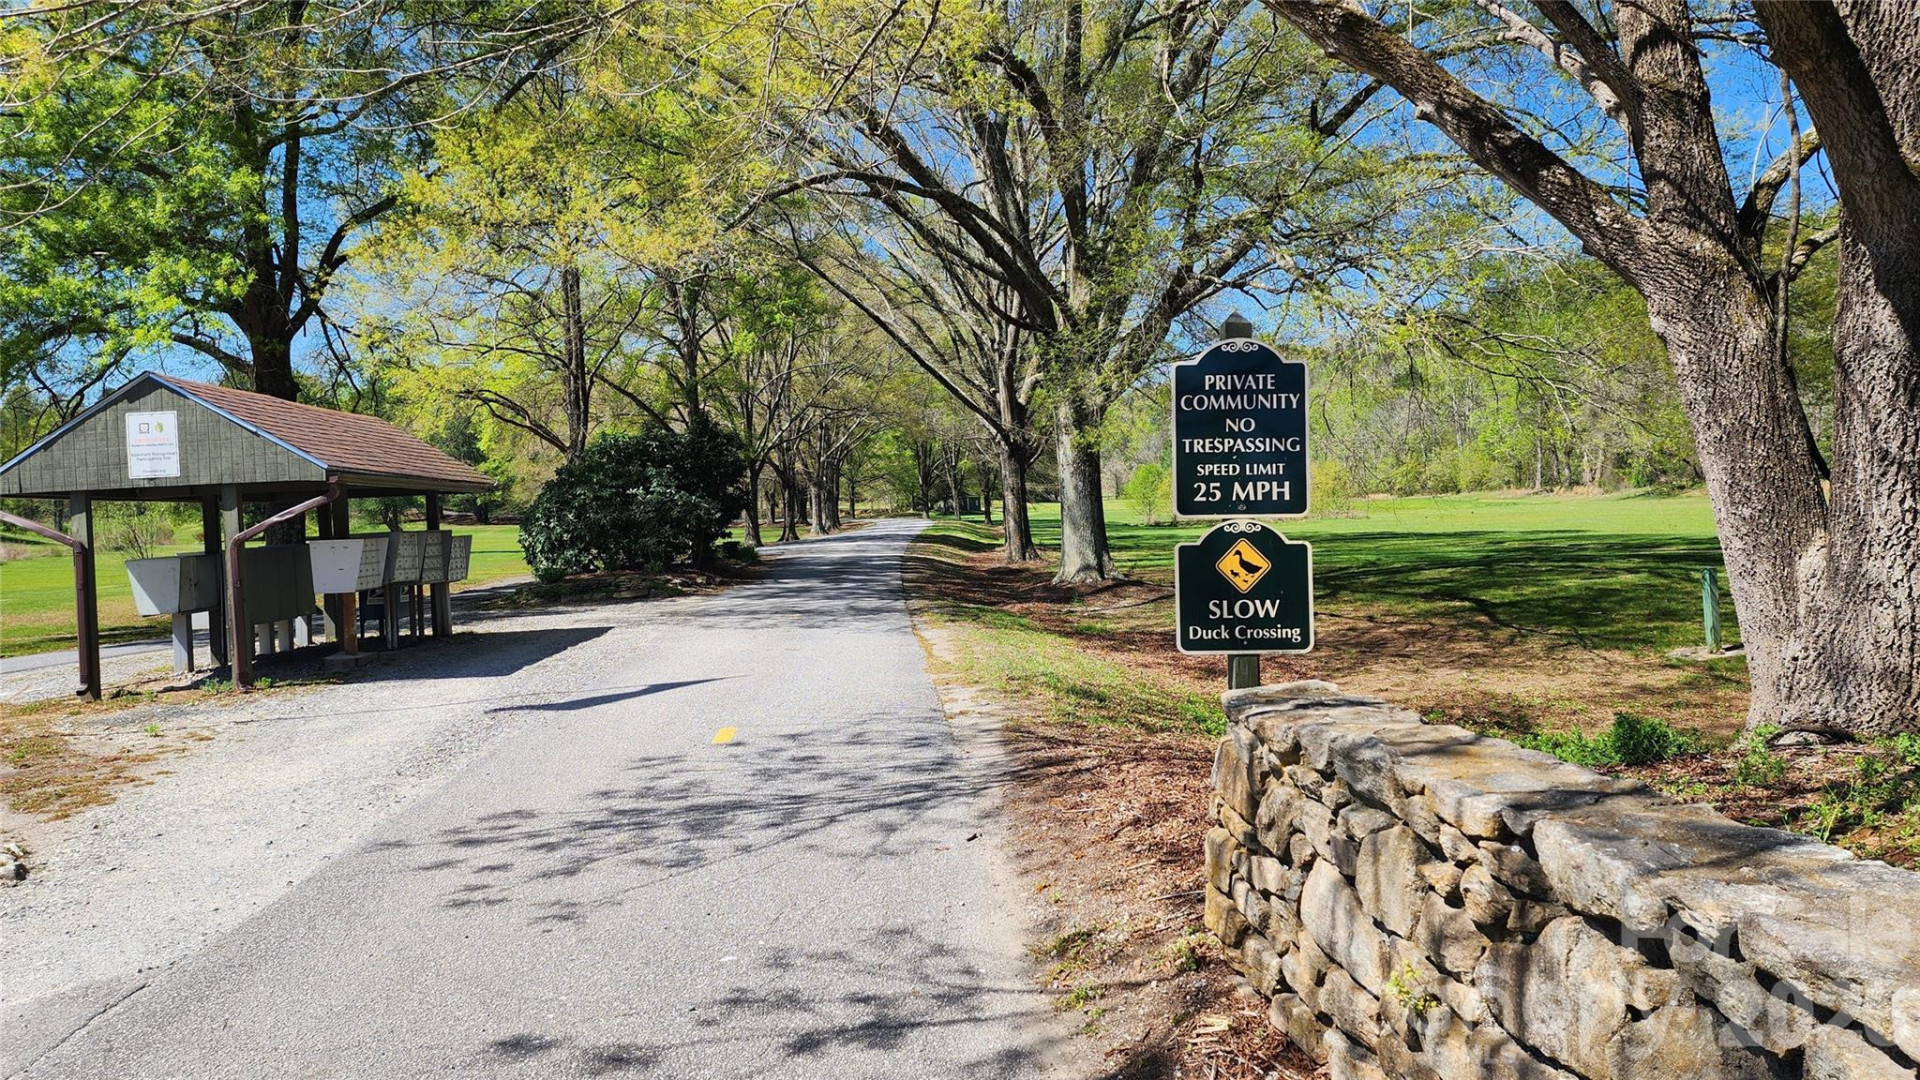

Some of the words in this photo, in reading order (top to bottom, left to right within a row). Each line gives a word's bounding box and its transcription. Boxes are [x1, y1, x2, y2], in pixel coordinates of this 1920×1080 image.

[1204, 373, 1276, 391] PRIVATE
[1180, 393, 1300, 411] COMMUNITY
[1225, 417, 1256, 433] NO
[1181, 436, 1301, 453] TRESPASSING
[1196, 463, 1240, 477] SPEED
[1246, 463, 1286, 476] LIMIT
[1193, 482, 1222, 502] 25
[1231, 481, 1291, 501] MPH
[1208, 599, 1281, 619] SLOW
[1188, 625, 1229, 640] Duck
[1234, 624, 1302, 644] Crossing
